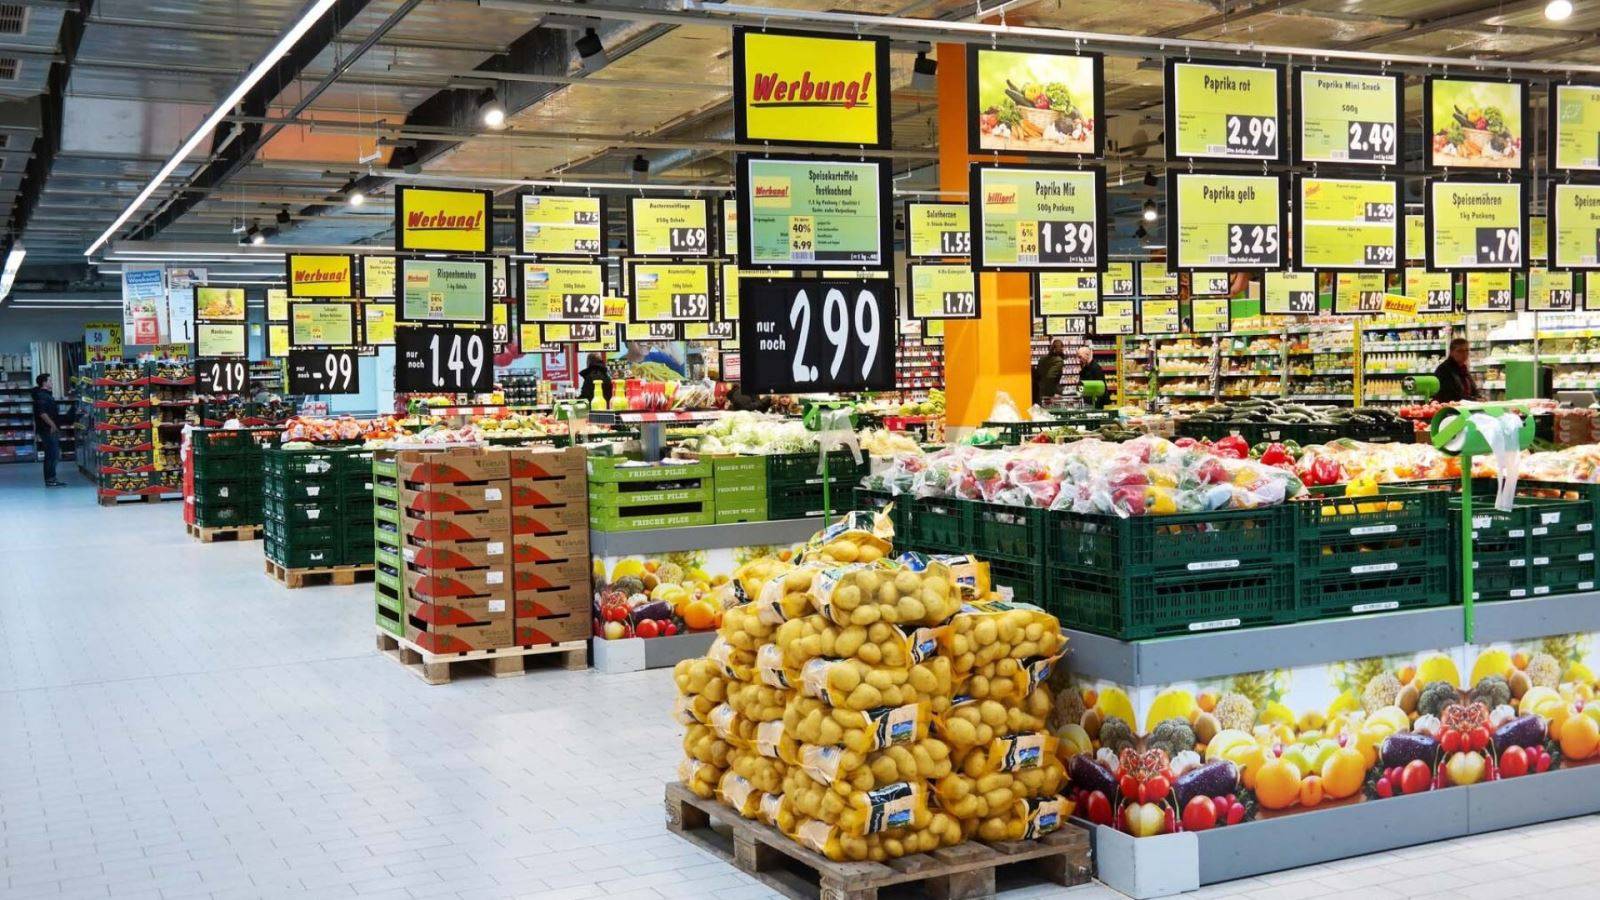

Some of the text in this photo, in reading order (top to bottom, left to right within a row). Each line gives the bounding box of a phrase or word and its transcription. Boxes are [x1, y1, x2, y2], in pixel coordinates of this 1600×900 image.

[753, 71, 872, 109] Werbung!
[1204, 75, 1250, 92] Paprika rot
[1318, 80, 1342, 90] Paprika
[1228, 116, 1276, 148] 2.99
[1350, 122, 1394, 152] 2.49
[808, 170, 858, 182] Speisekartoffeln
[816, 185, 852, 196] festkochend
[1036, 182, 1075, 199] Paprika Mix
[1204, 186, 1256, 204] Paprika gelb
[1452, 192, 1502, 208] Speisemöhren
[1366, 203, 1393, 217] 1.29
[408, 210, 482, 232] Werbung!
[792, 224, 811, 233] 40%
[672, 229, 705, 246] 1.69
[793, 241, 811, 250] 4.99
[944, 232, 970, 252] 1.55
[1041, 222, 1093, 254] 1.39
[1230, 225, 1277, 254] 3.25
[1481, 229, 1519, 262] -.79
[1366, 246, 1393, 260] 1.99
[295, 268, 348, 283] Werbung!
[565, 294, 600, 313] 1.29
[674, 294, 707, 316] 1.59
[946, 293, 973, 313] 1.79
[1292, 292, 1314, 310] -.99
[1361, 292, 1382, 310] 1.49
[1429, 291, 1451, 306] 2.49
[1551, 291, 1571, 304] 1.79
[571, 324, 595, 336] 1.79
[650, 324, 673, 334] 1.99
[709, 322, 731, 334] 1.99
[756, 321, 775, 332] nur
[790, 287, 880, 382] 2.99
[760, 334, 786, 350] noch
[408, 359, 424, 368] noch
[430, 334, 484, 387] 1.49
[313, 354, 352, 390] -.99
